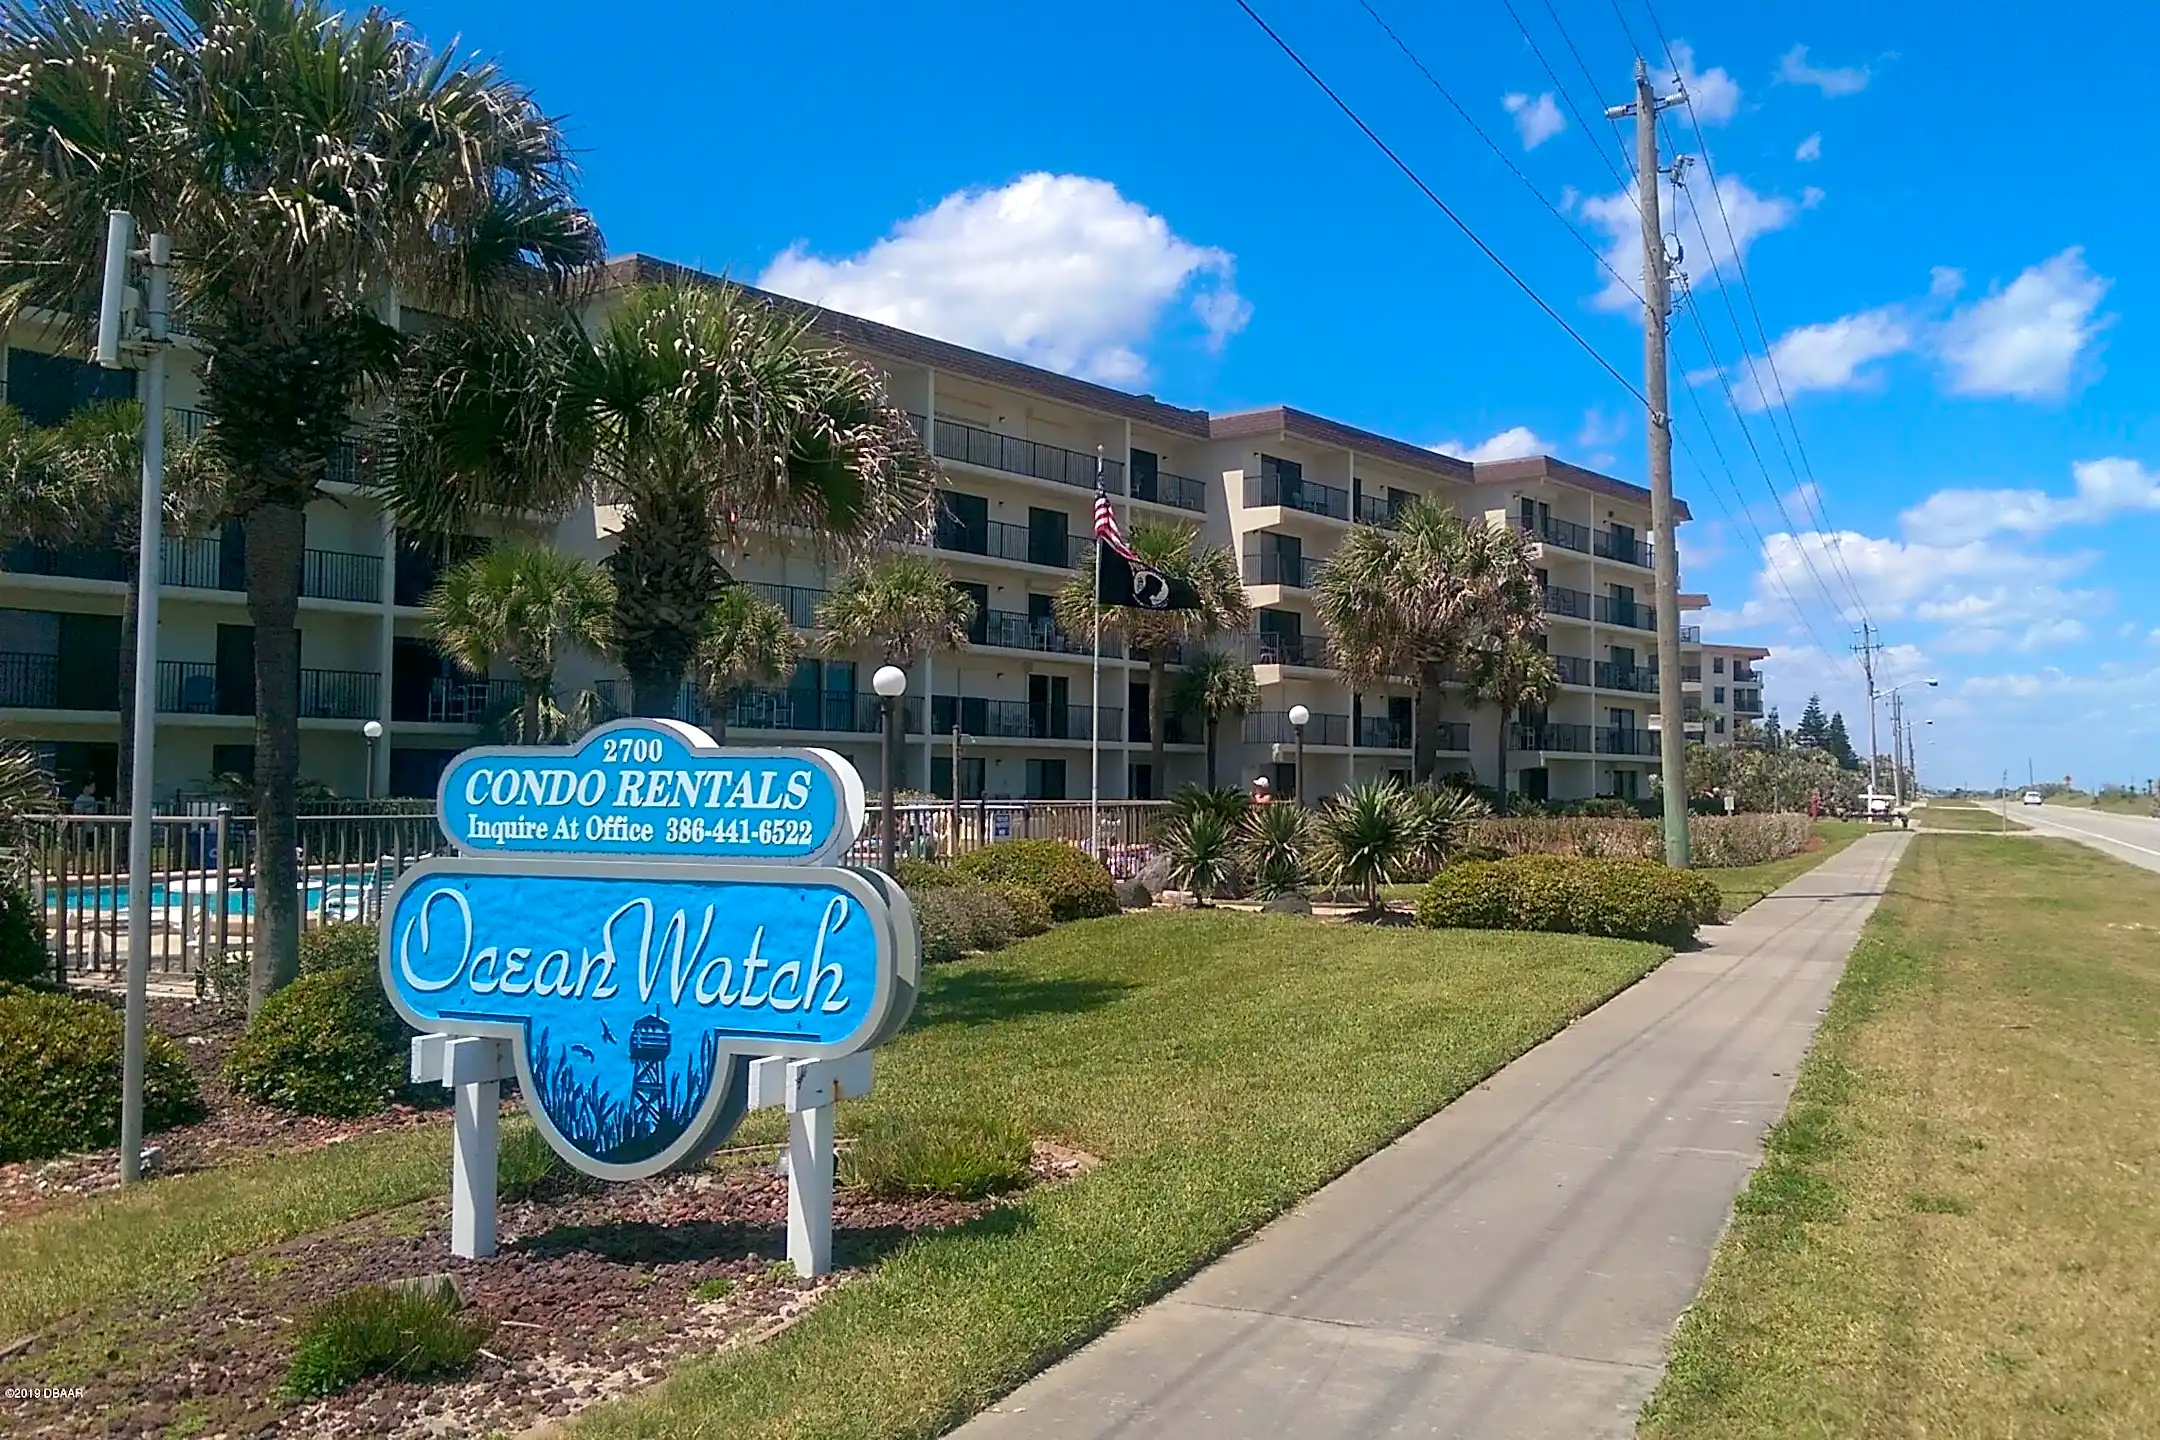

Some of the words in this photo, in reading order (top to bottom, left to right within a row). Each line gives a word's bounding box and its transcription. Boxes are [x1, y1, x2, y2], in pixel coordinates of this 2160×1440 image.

[602, 738, 663, 763] 2700
[465, 768, 607, 807] CONDO
[612, 769, 813, 810] RENTALS
[467, 813, 549, 845] Inquire
[552, 815, 579, 840] At
[585, 814, 654, 842] Office
[665, 816, 813, 846] 386-441-6522
[400, 887, 619, 1000] Ocean
[601, 894, 851, 1013] Watch
